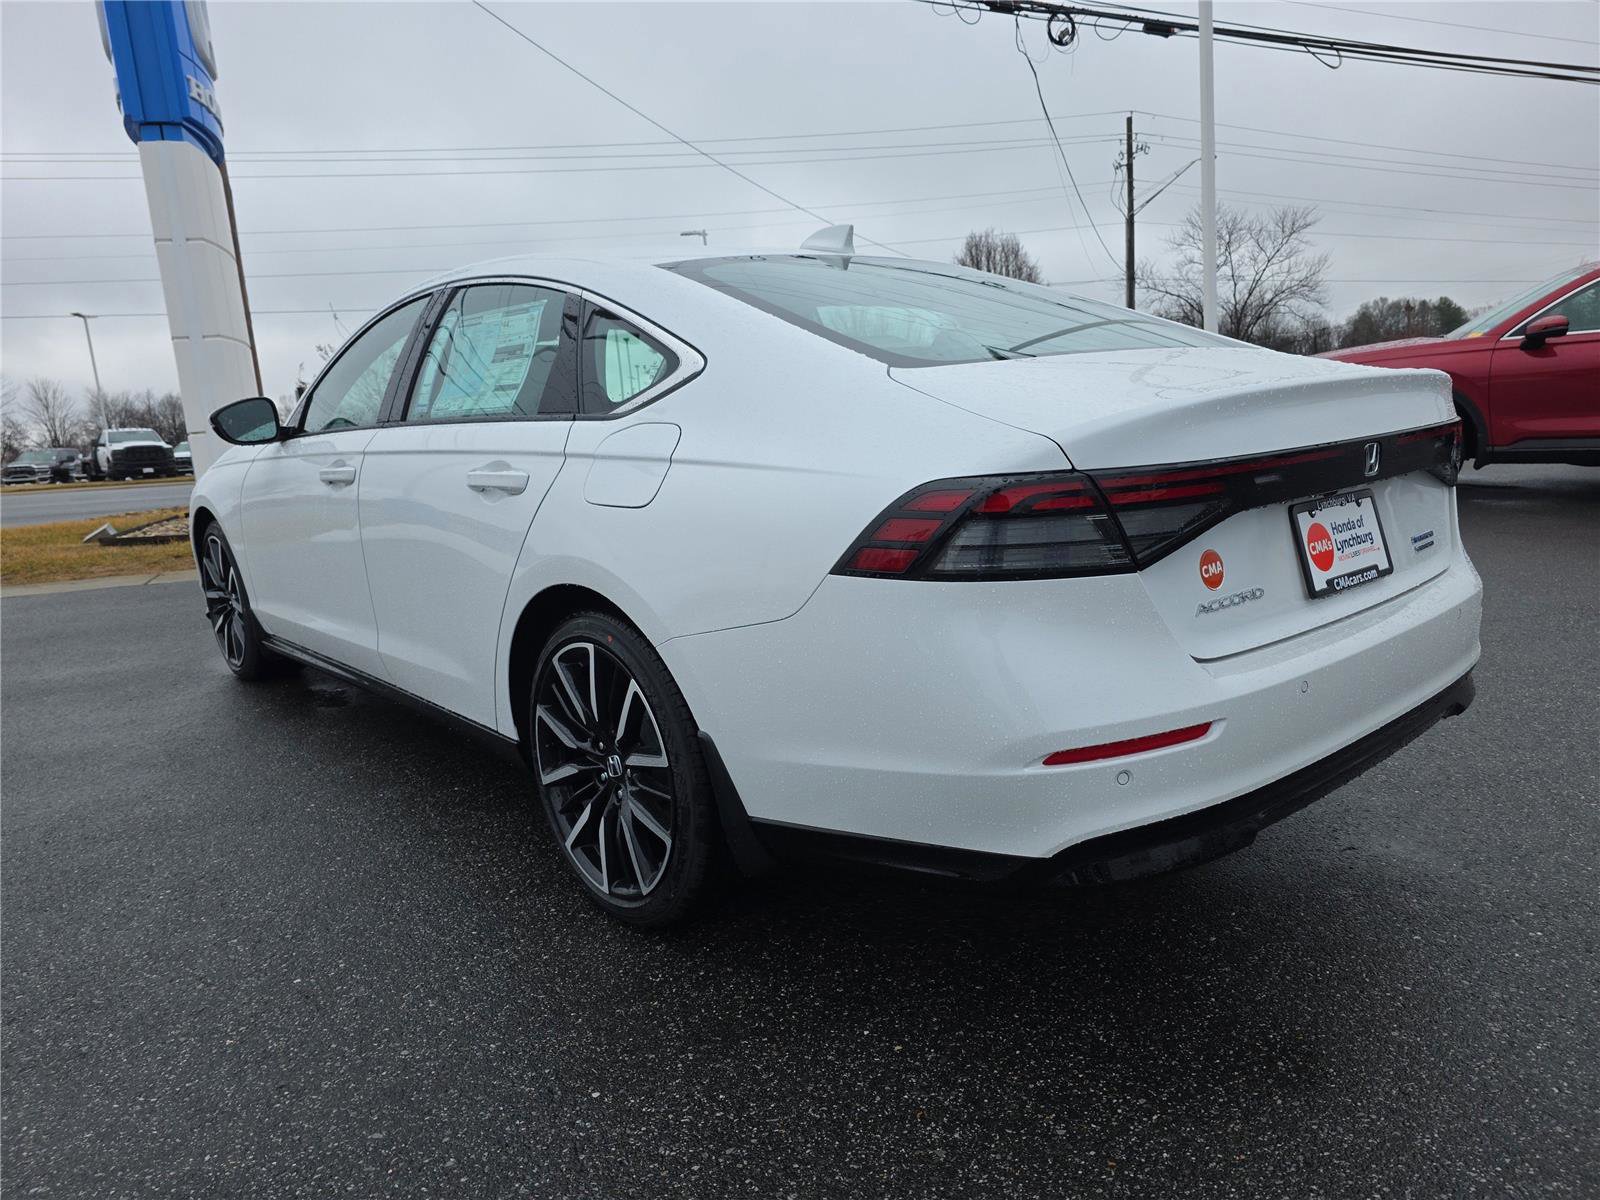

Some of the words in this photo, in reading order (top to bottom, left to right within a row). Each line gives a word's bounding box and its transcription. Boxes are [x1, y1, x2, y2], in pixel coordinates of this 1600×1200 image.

[1330, 518, 1356, 535] Honda
[1356, 515, 1365, 528] of
[1309, 538, 1333, 556] CMA's
[1334, 531, 1375, 553] Lynchburg
[1202, 561, 1223, 578] CMA
[1333, 568, 1378, 591] CMAcars.com
[1195, 587, 1265, 618] ACCORD
